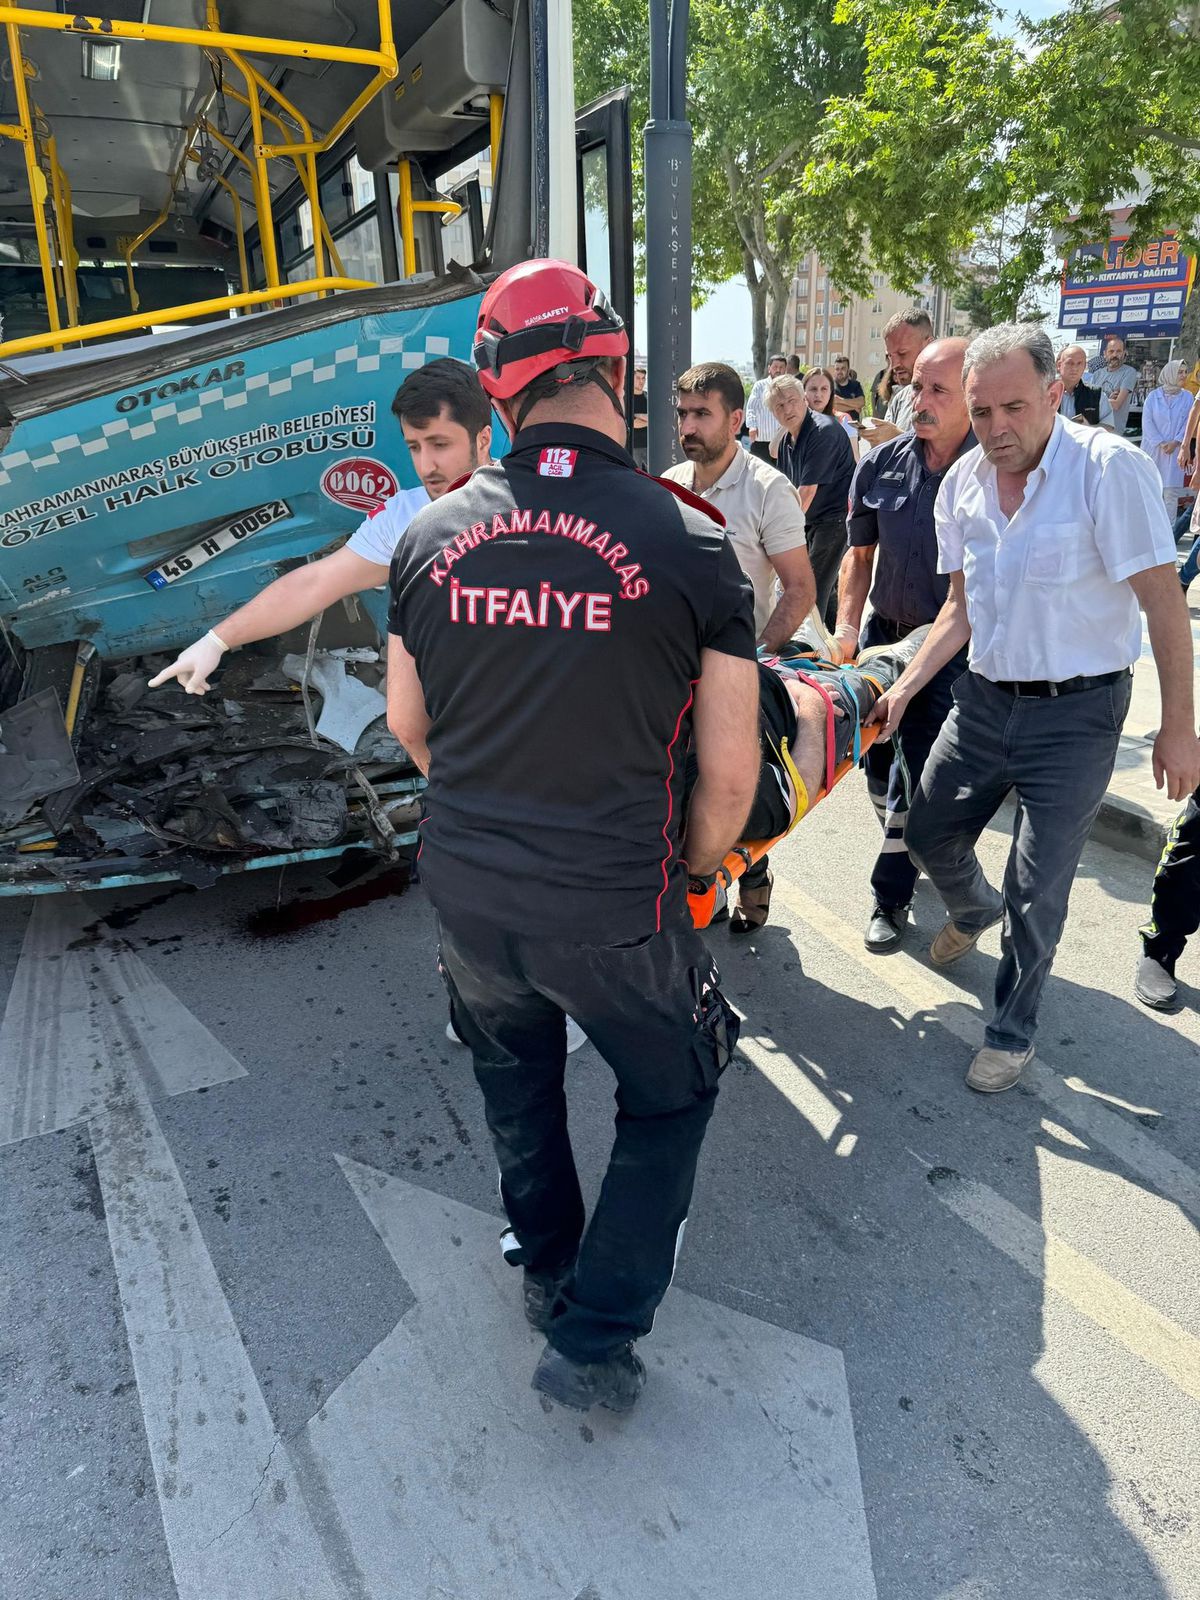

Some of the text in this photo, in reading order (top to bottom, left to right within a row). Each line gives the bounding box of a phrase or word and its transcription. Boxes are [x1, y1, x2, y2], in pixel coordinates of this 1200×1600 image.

[115, 360, 246, 412] OTOKAR
[168, 423, 279, 470] BÜYÜKŞEHİR
[283, 400, 376, 437] BELEDİYESİ
[546, 448, 571, 465] 112
[0, 426, 376, 548] ÖZEL HALK OTOBÜSÜ
[329, 470, 392, 501] 0062
[154, 501, 286, 587] TR 46 H 0062
[429, 509, 650, 601] KAHRAMANMARAŞ
[449, 576, 612, 632] İTFAİYE
